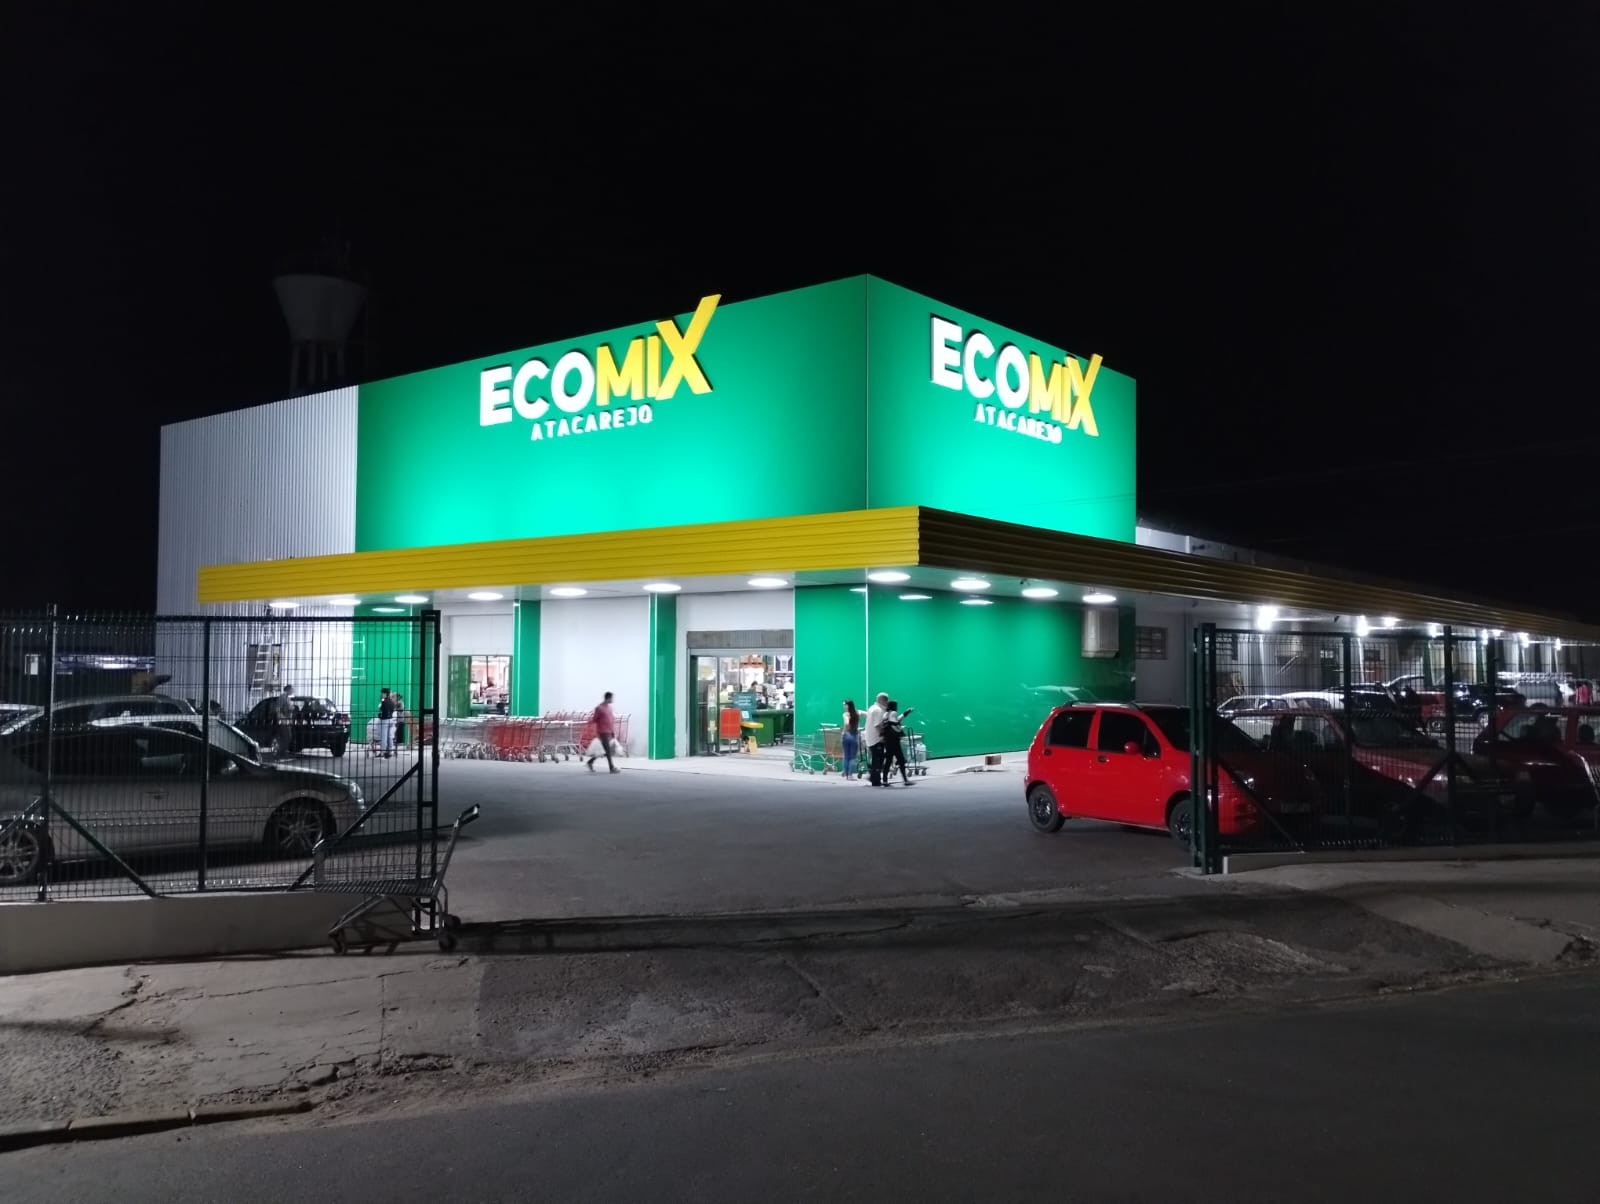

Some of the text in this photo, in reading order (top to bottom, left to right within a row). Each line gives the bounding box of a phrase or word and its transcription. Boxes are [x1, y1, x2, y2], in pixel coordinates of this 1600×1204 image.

[479, 294, 722, 426] ECOMIX
[930, 314, 1103, 437] ECOMIX
[530, 404, 653, 441] ATACAREJO
[974, 402, 1062, 444] ATACAREJO
